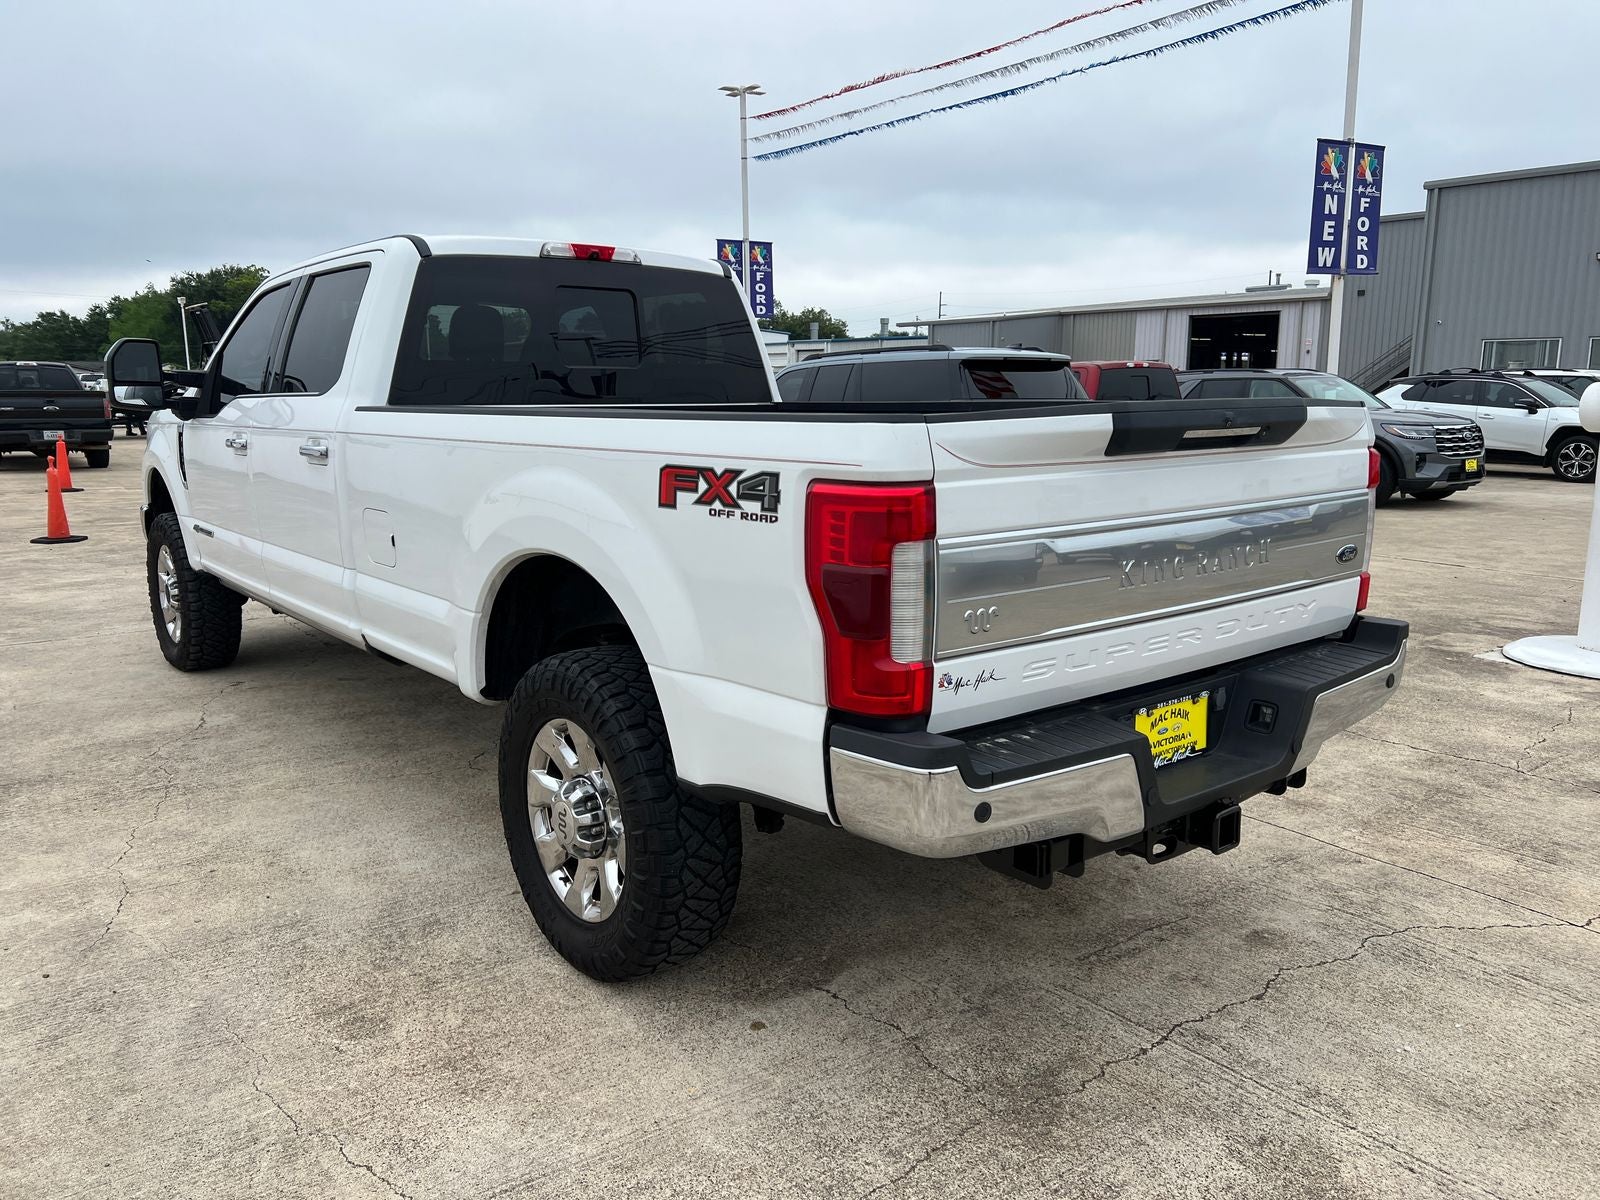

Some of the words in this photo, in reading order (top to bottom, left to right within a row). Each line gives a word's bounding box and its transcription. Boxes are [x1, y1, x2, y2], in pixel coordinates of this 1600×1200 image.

[1317, 193, 1338, 268] NEW
[1356, 197, 1371, 269] FORD
[755, 271, 767, 315] FORD
[658, 463, 782, 514] FX4
[708, 507, 736, 519] OFF
[740, 511, 779, 524] ROAD
[1118, 555, 1185, 590] KING
[1195, 537, 1272, 577] RANCH
[1022, 626, 1204, 683] SUPER
[1215, 599, 1317, 640] DUTY
[951, 676, 973, 695] Mac
[973, 668, 1006, 691] Haik
[1149, 709, 1169, 733] MAC
[1170, 707, 1191, 722] HAIK
